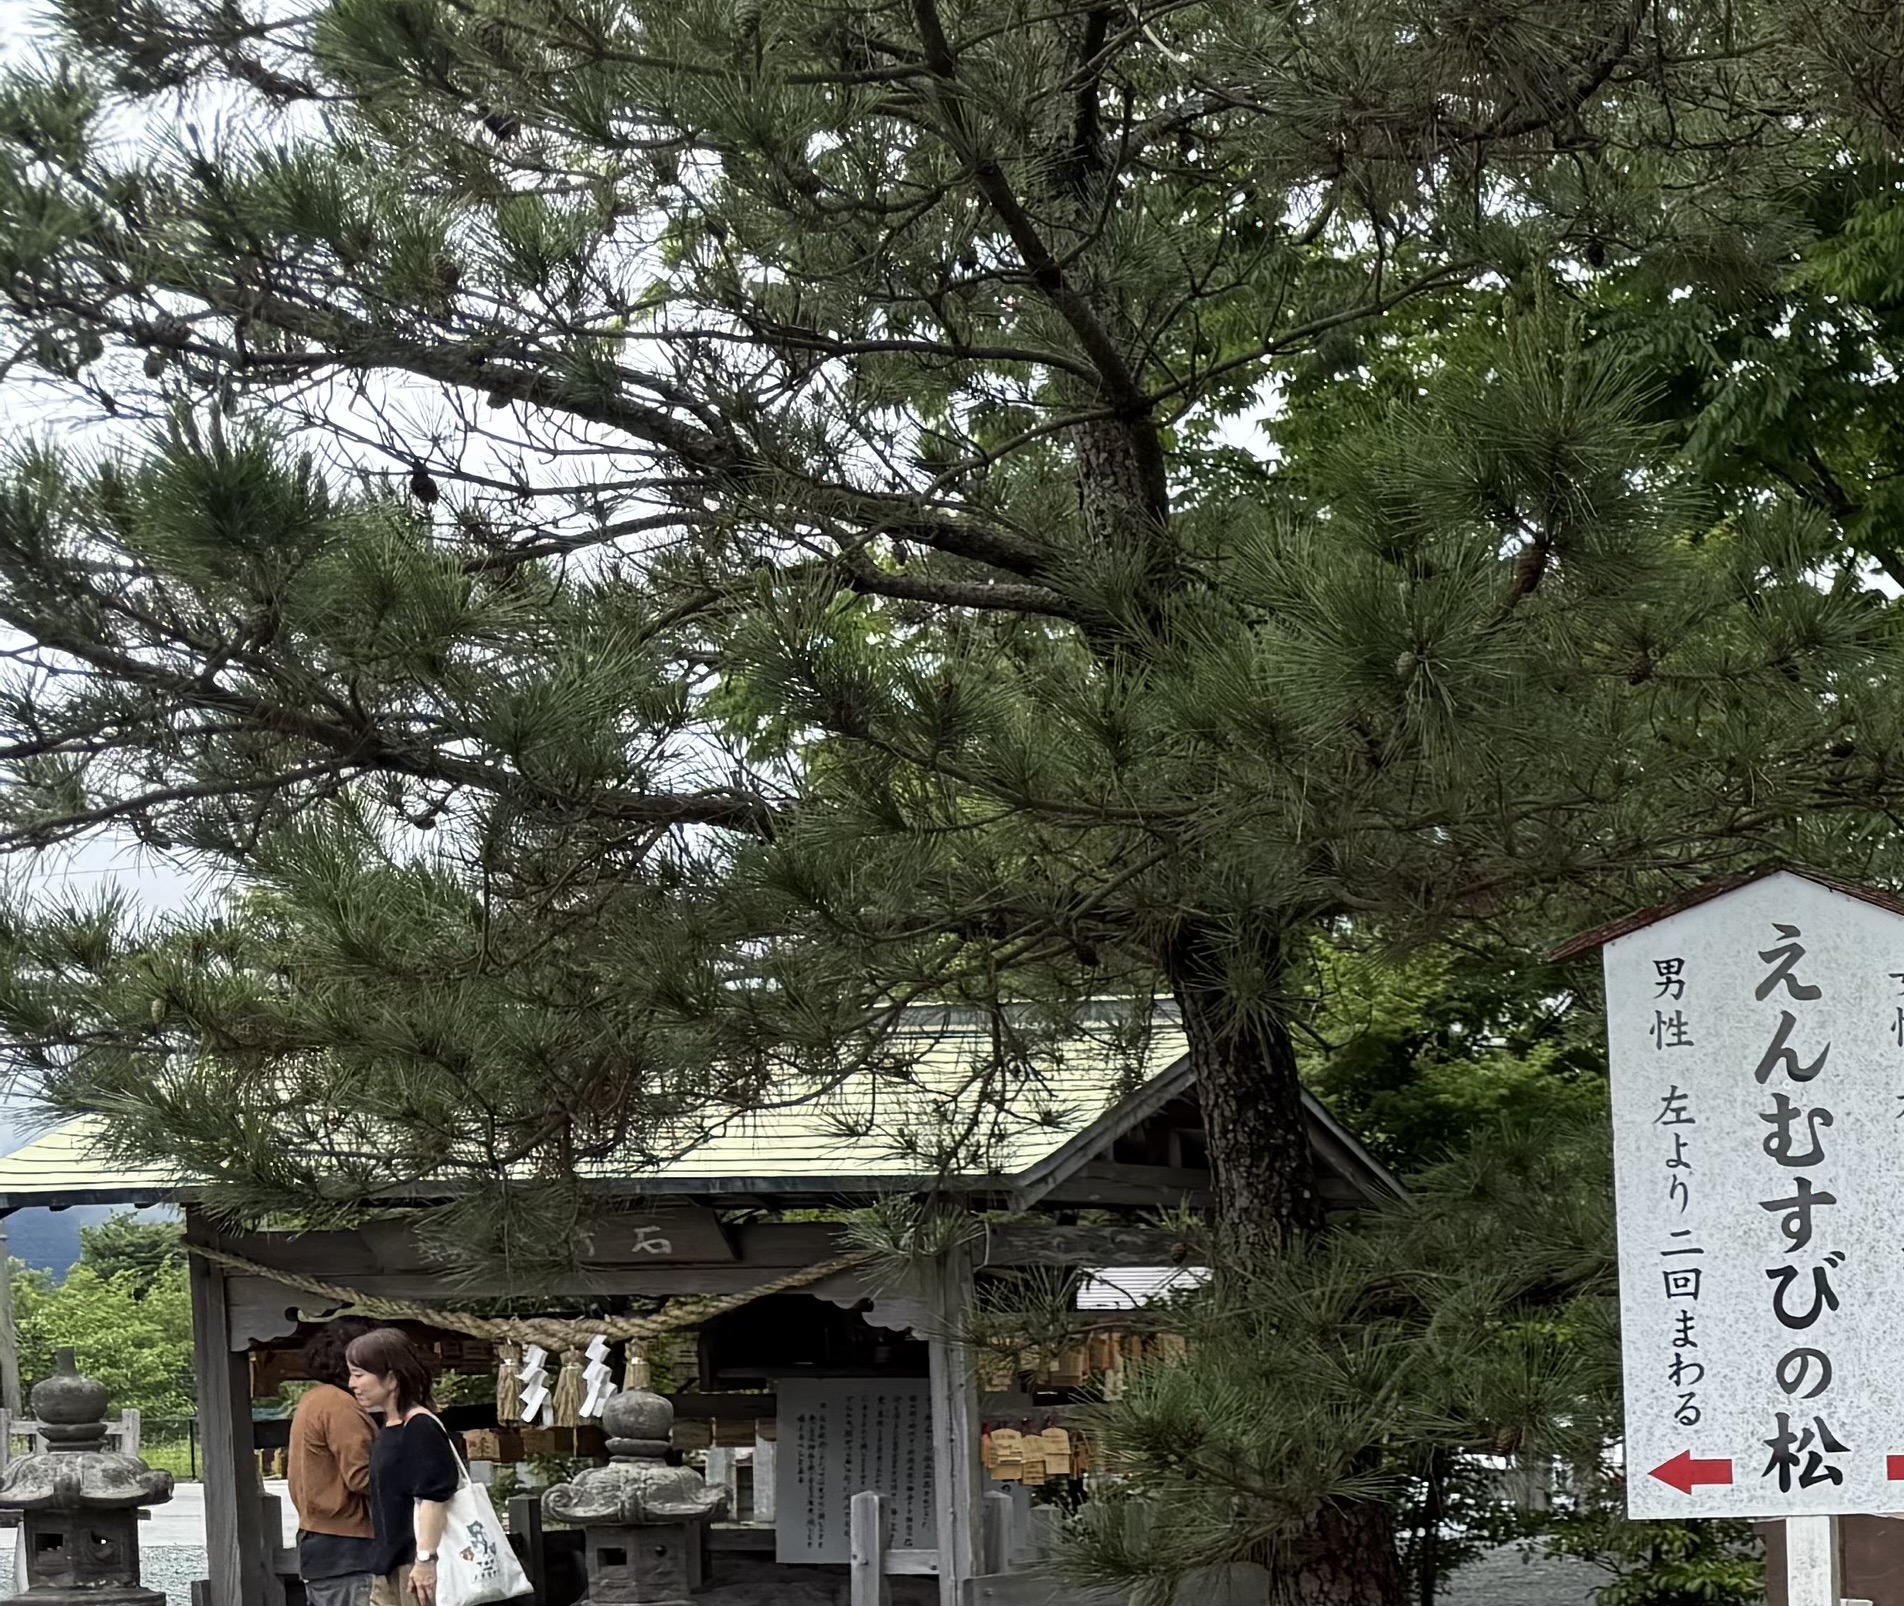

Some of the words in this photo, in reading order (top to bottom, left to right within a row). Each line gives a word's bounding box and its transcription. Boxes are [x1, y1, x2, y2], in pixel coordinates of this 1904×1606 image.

[1649, 956, 1696, 1051] 男性
[1652, 1084, 1705, 1427] 左より二回まわる
[1754, 922, 1851, 1493] えんむすびの松
